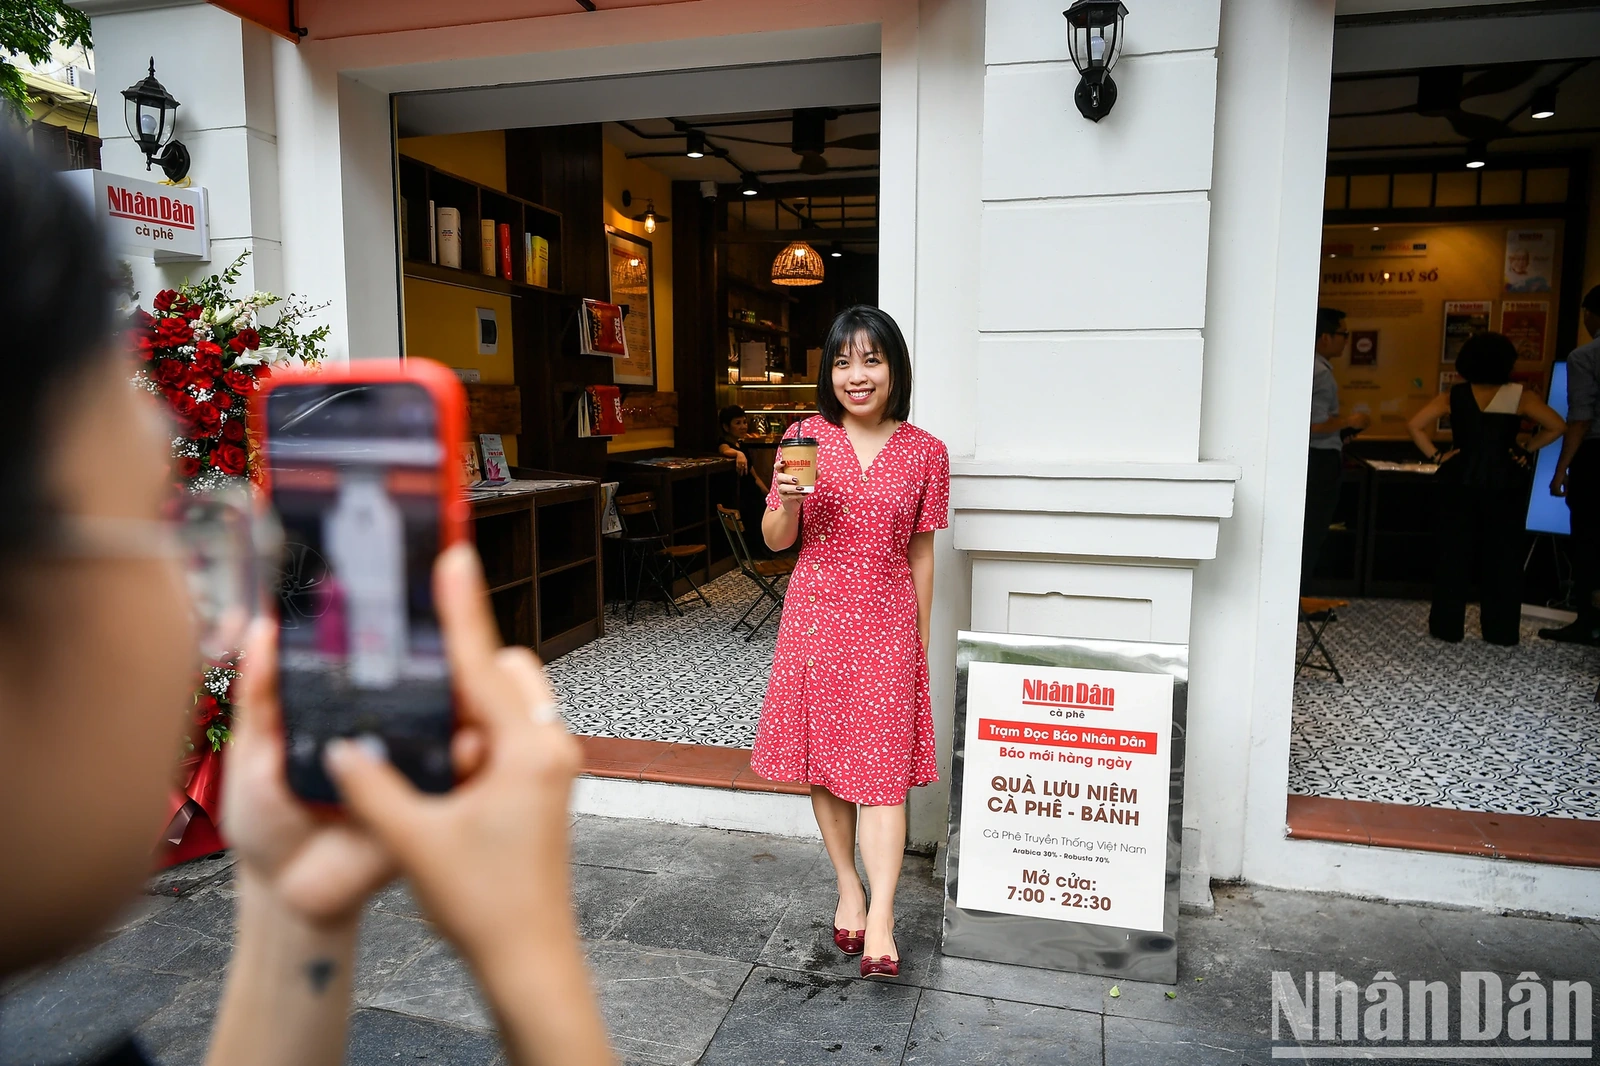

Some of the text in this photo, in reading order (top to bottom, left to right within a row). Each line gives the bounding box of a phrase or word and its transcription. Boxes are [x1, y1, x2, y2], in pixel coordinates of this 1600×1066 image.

[107, 185, 195, 225] Nhân Dân
[135, 224, 174, 240] cà phê
[1398, 268, 1416, 283] LÝ
[1418, 267, 1439, 282] SỐ
[1022, 678, 1115, 706] Nhân Dân
[1049, 708, 1086, 719] cà phê
[989, 724, 1147, 748] Trạm Đọc Báo Nhân Dân
[999, 746, 1133, 771] Báo mới hàng ngày
[991, 774, 1138, 807] QUÀ LƯU NIỆM
[987, 794, 1018, 814] CÀ
[1024, 799, 1063, 818] PHÊ
[1081, 803, 1140, 827] BÁNH
[982, 828, 1147, 855] Cà Phê Truyền Thống Việt Nam
[1012, 847, 1042, 857] Arabica
[1043, 850, 1058, 858] 30%
[1063, 852, 1093, 862] Robusta
[1095, 855, 1111, 864] 70%
[1022, 868, 1097, 891] Mở cửa:
[1007, 885, 1045, 904] 7:00
[1061, 892, 1112, 912] 22:30
